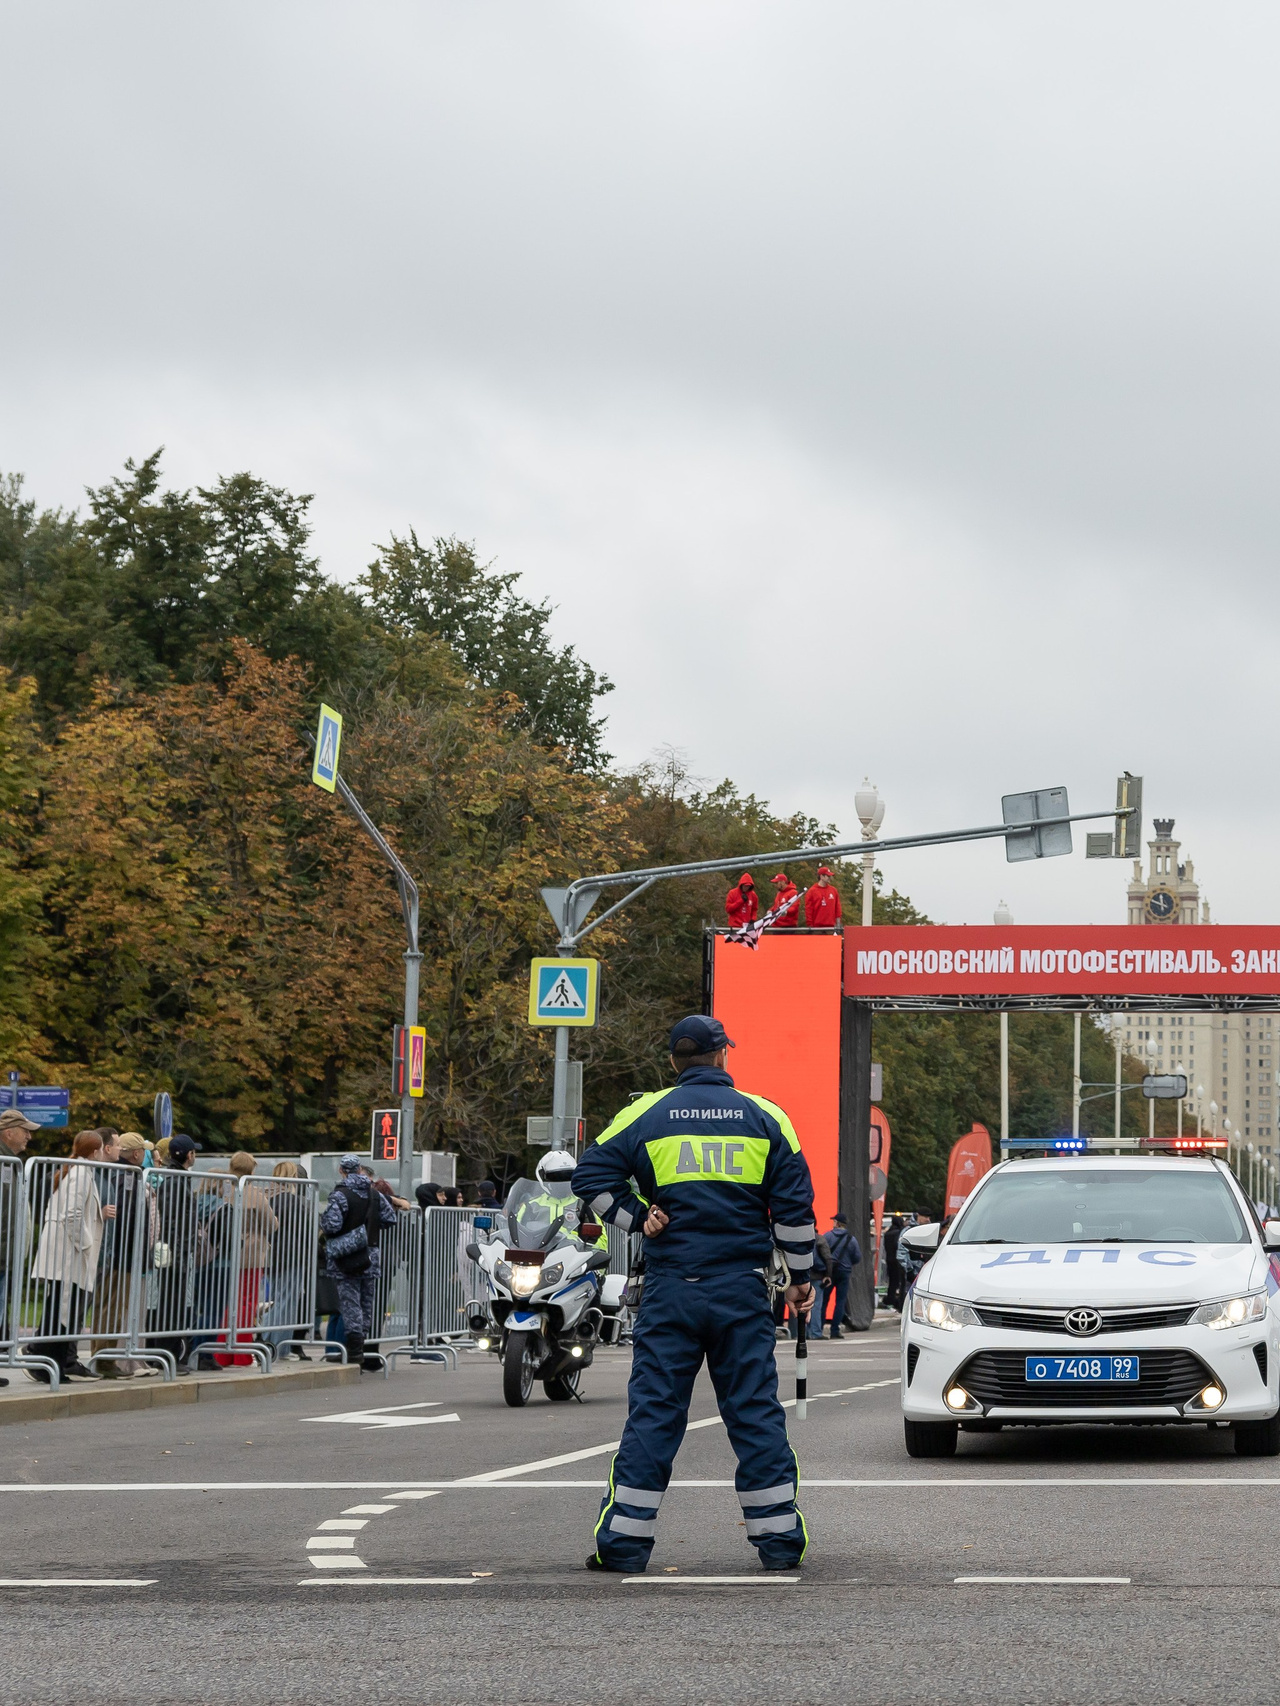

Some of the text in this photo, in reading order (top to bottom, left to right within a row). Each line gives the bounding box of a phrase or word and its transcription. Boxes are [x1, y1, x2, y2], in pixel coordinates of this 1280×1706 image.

[856, 946, 1014, 974] МОСКОВСКИЙ
[1020, 949, 1227, 974] МОТОФЕСТИВАЛЬ.
[669, 1109, 744, 1119] ПОЛИЦИЯ
[675, 1141, 744, 1175] ДПС
[980, 1249, 1197, 1268] ДПС
[1054, 1359, 1102, 1378] 7408
[1113, 1358, 1132, 1373] 99
